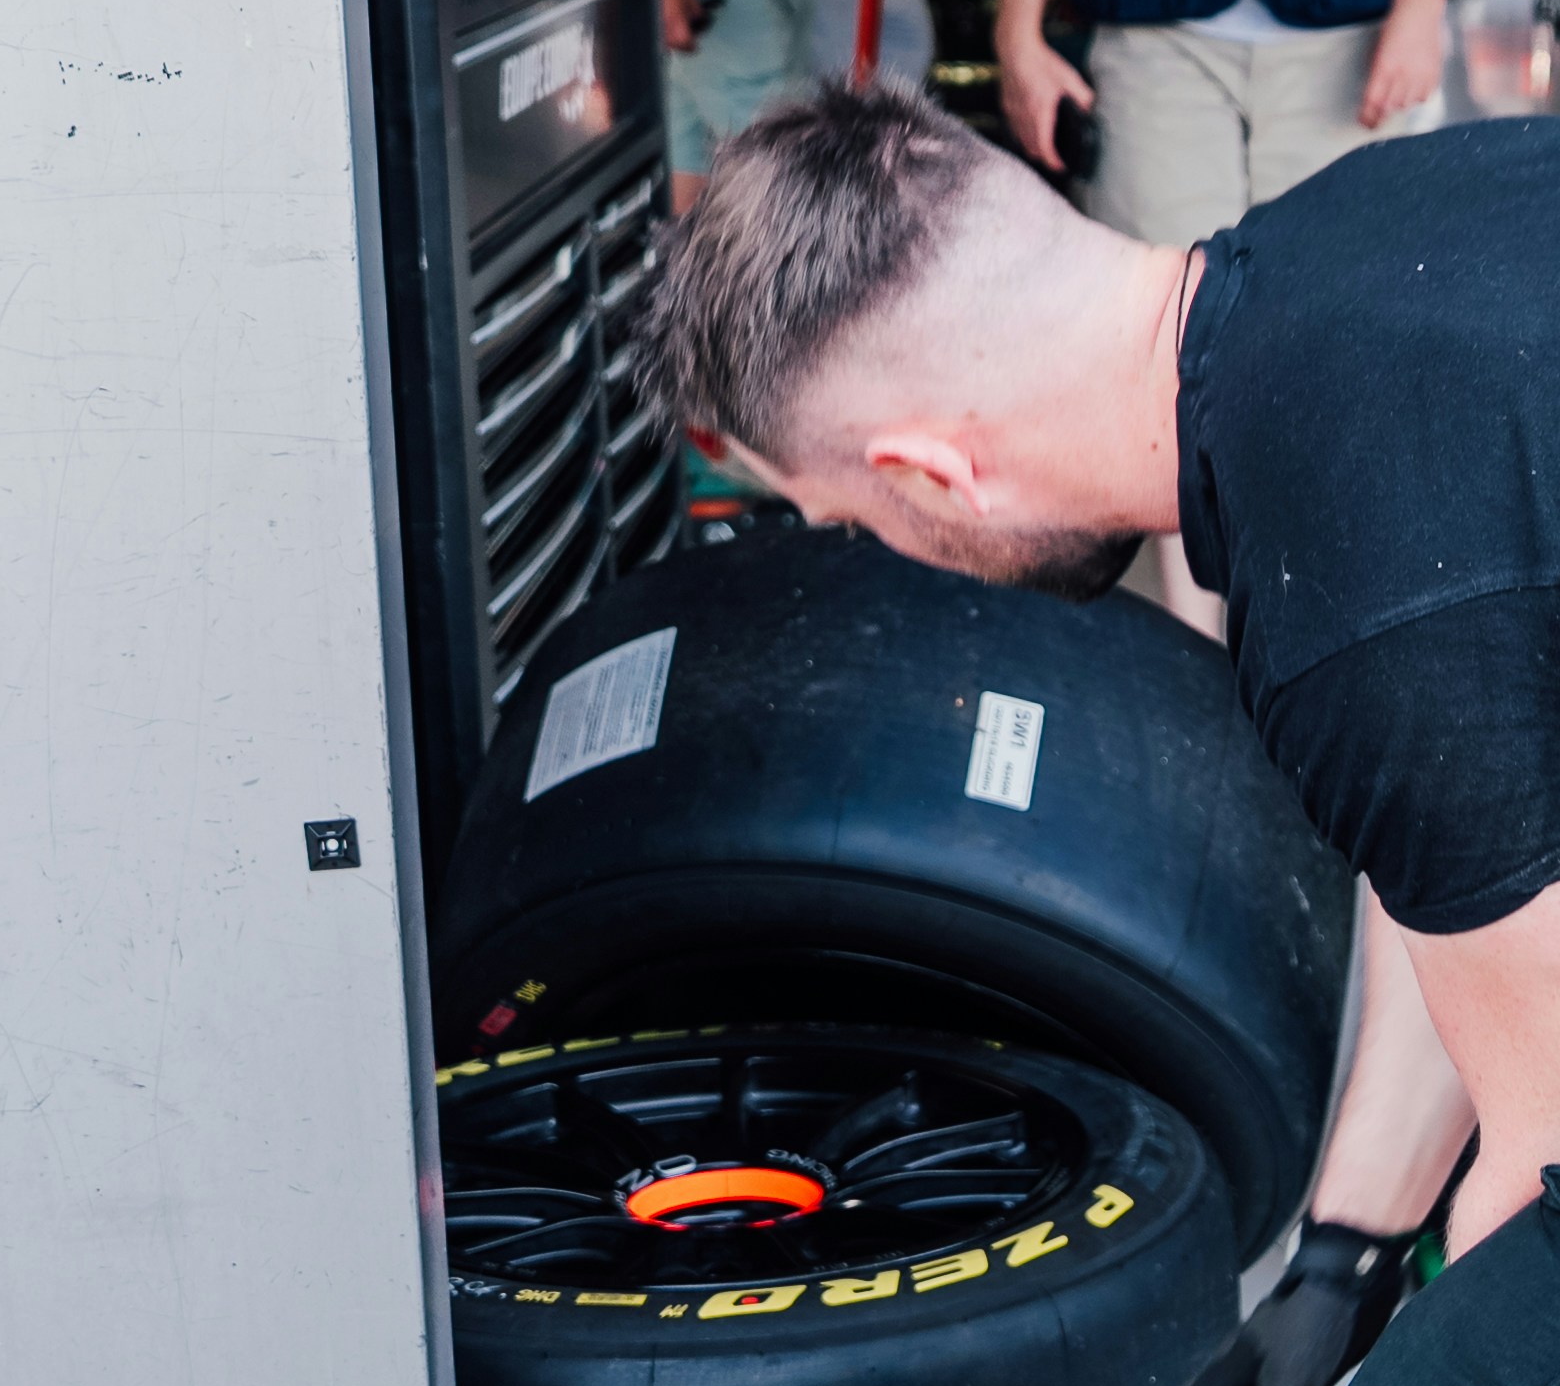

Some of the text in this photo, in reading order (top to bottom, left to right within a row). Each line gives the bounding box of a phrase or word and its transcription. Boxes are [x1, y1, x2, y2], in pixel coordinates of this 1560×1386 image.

[1083, 1181, 1134, 1228] P
[695, 1219, 1069, 1320] ZERO
[512, 1288, 562, 1305] DHG
